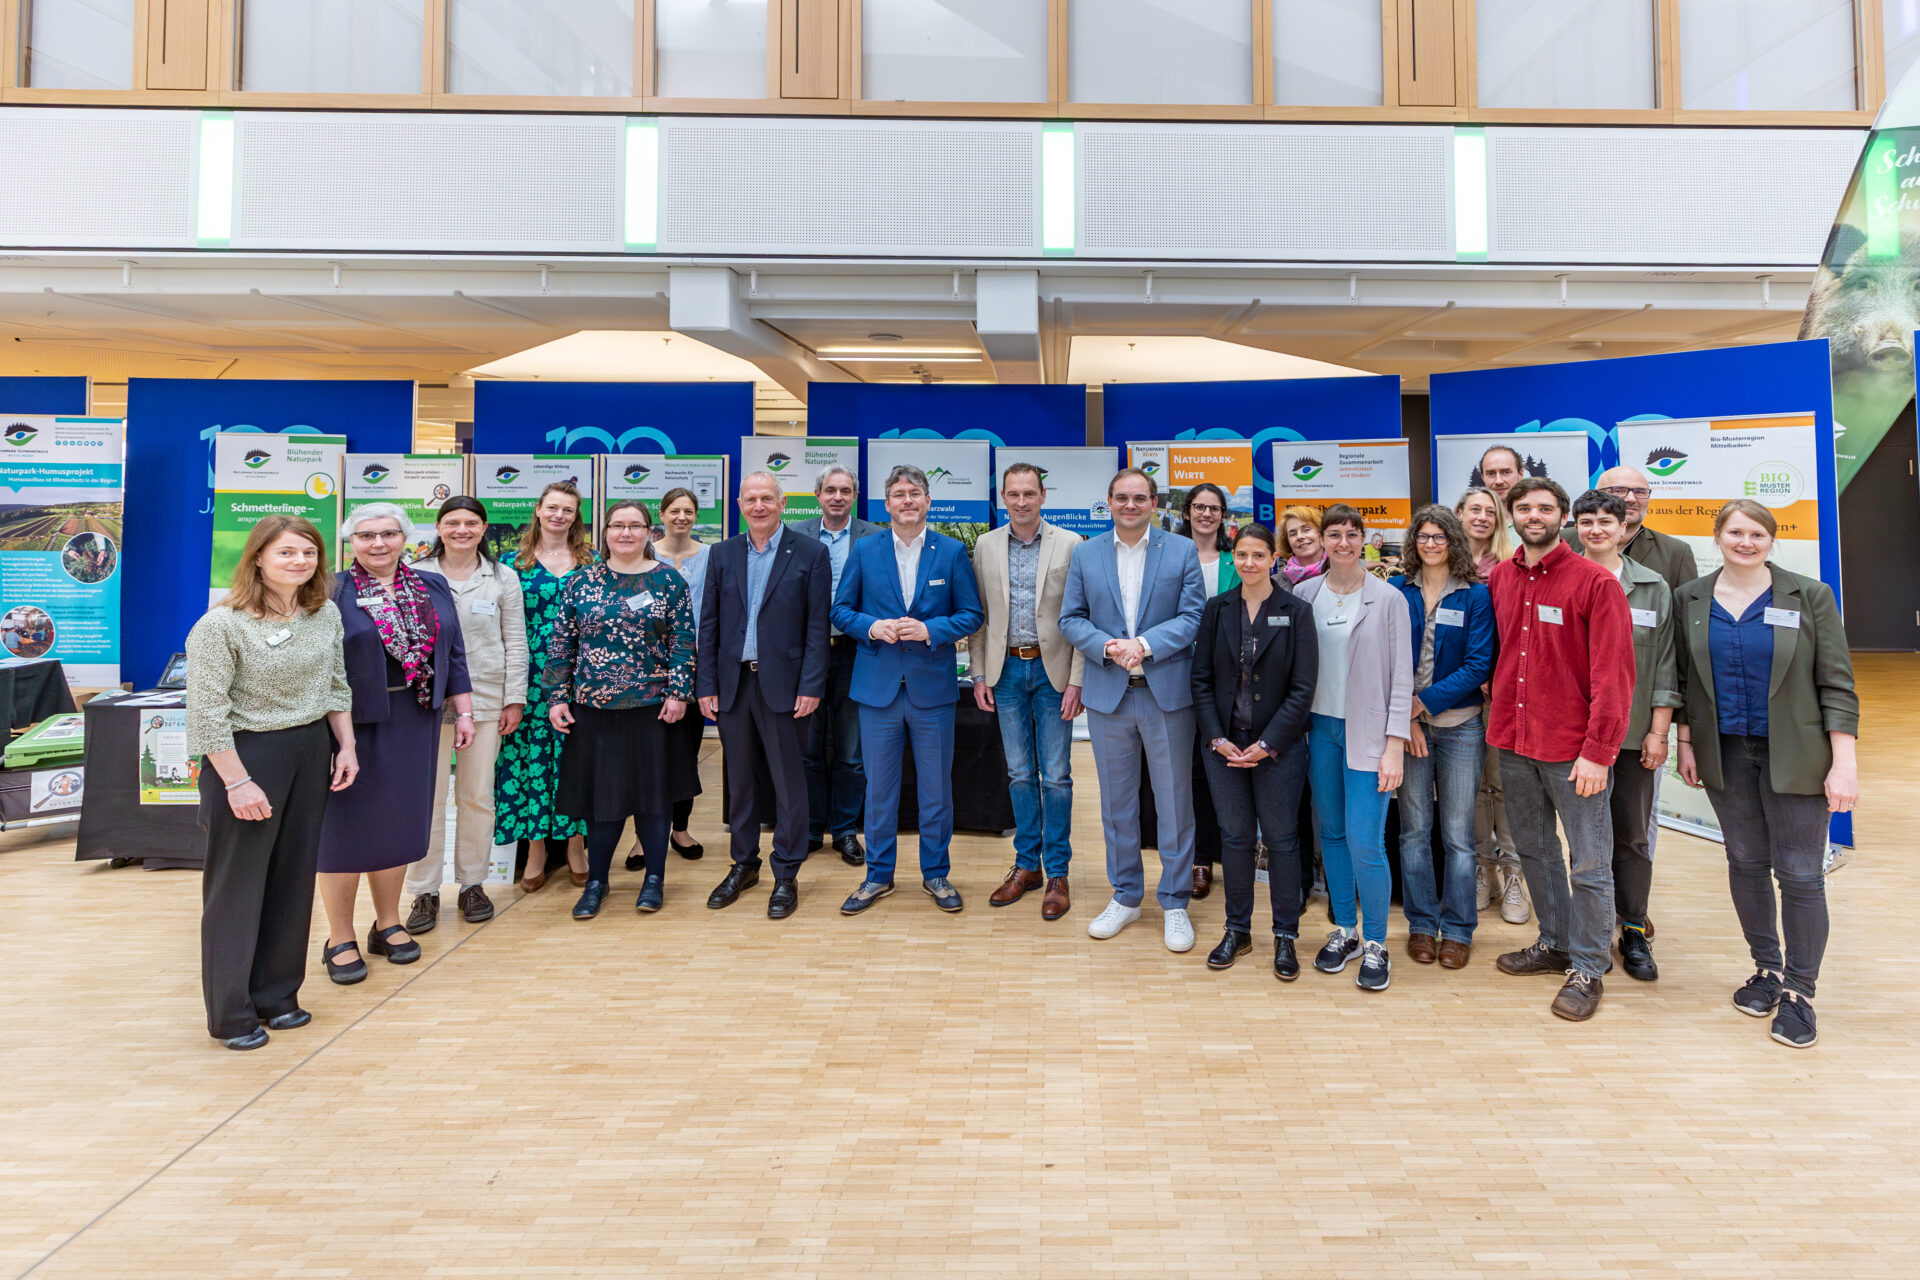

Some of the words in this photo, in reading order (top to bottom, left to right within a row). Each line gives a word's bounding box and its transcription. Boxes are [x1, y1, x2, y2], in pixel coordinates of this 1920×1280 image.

[1174, 455, 1236, 464] NATURPARK-
[1174, 471, 1205, 479] WIRTE
[1761, 472, 1790, 482] BIO
[231, 503, 307, 515] Schmetterlinge
[783, 506, 824, 515] umenwie
[1656, 507, 1673, 515] aus
[1676, 505, 1693, 515] der
[1043, 513, 1087, 521] AugenBlicke
